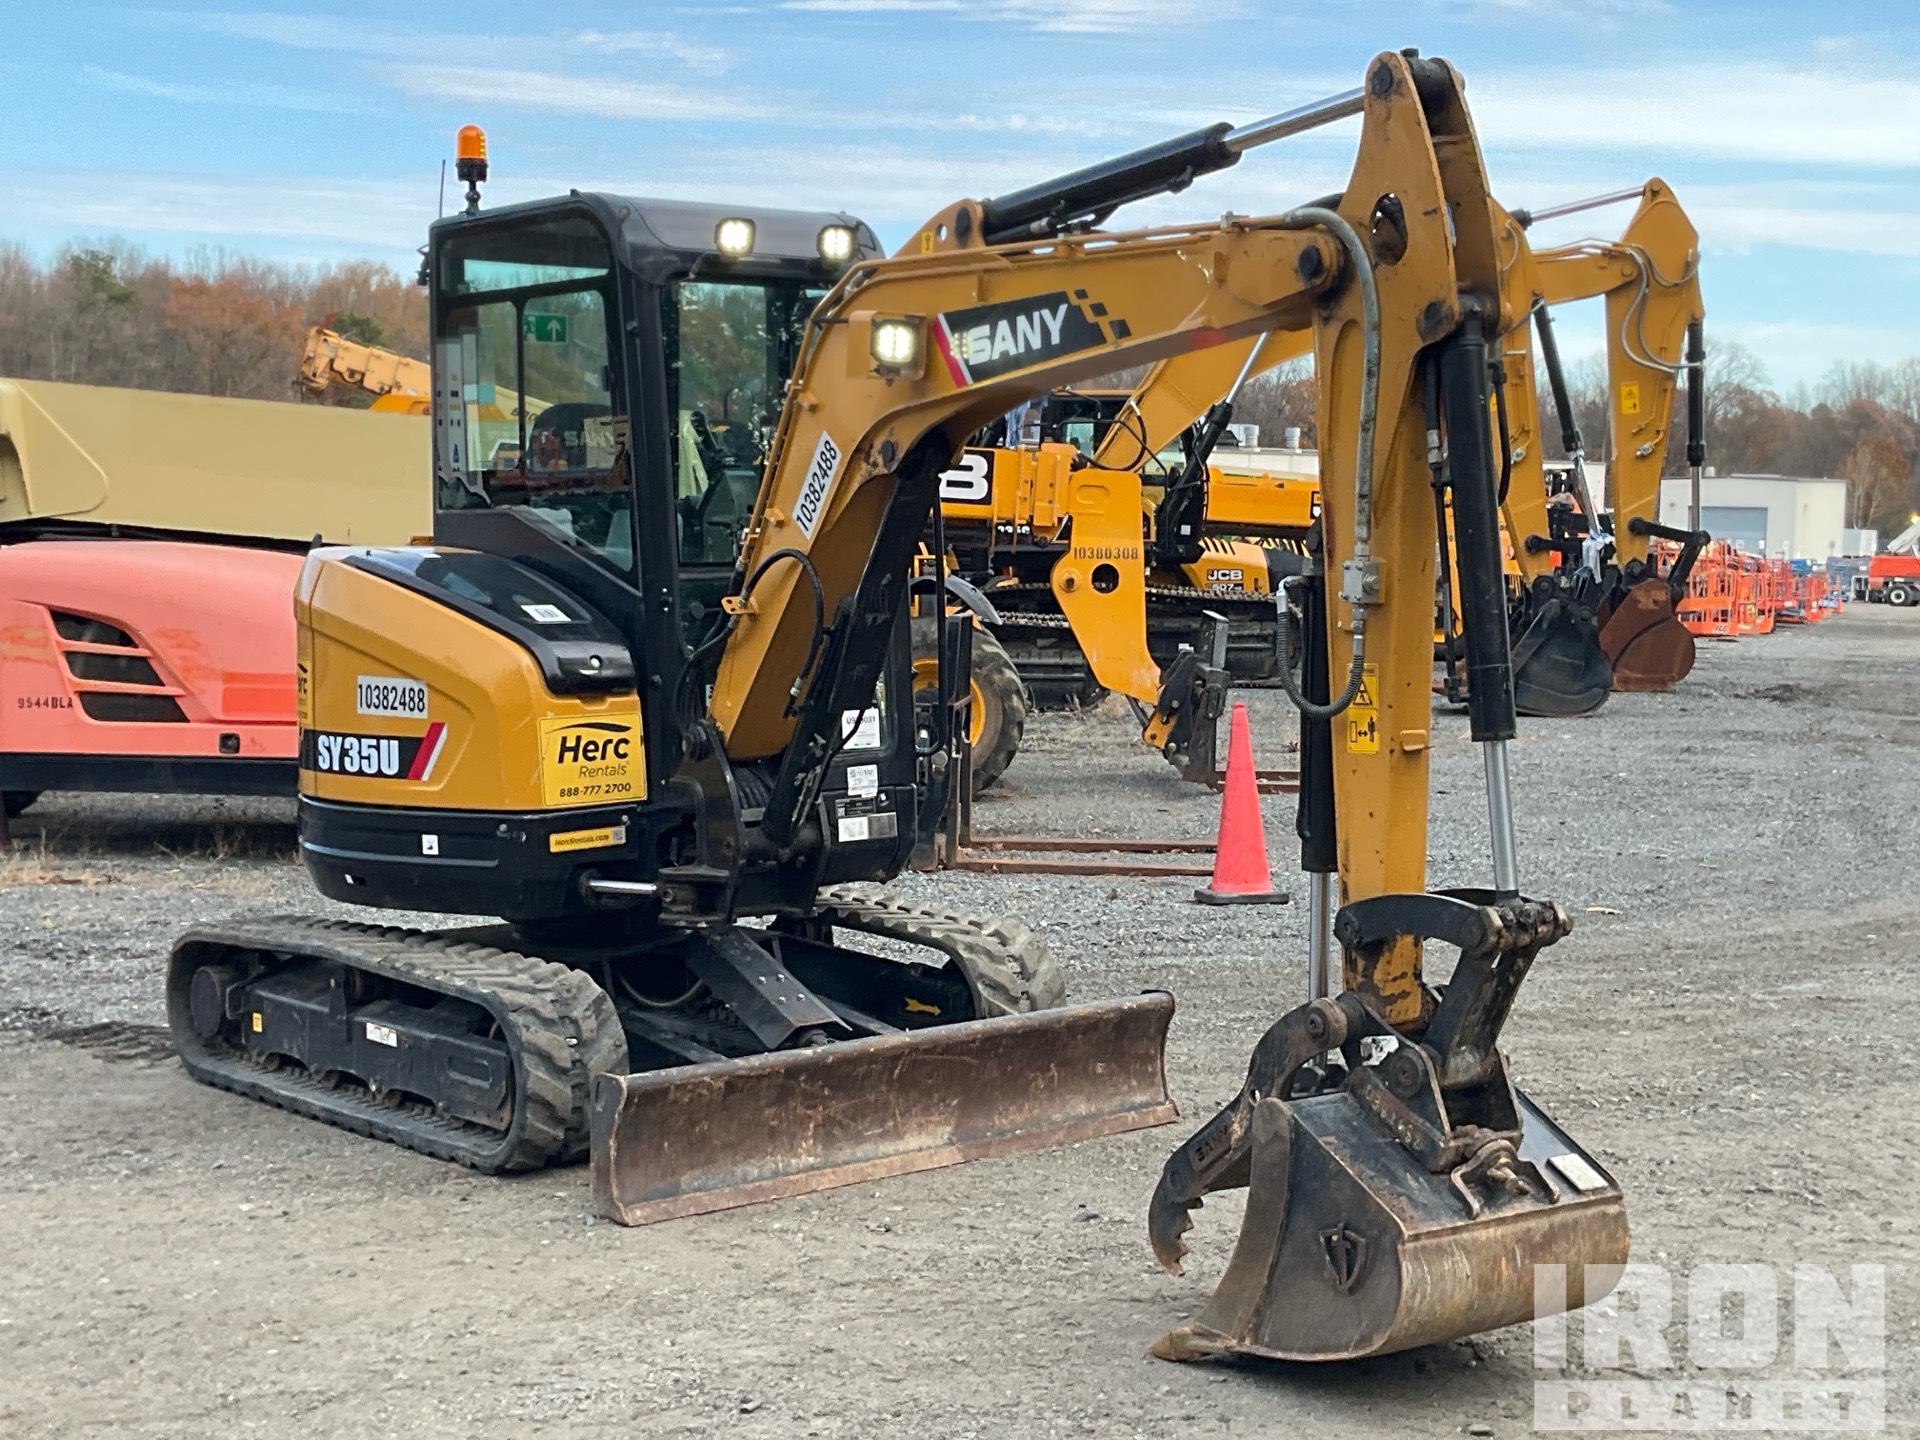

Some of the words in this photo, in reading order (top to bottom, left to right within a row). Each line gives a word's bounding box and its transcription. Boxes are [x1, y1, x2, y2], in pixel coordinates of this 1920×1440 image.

[968, 303, 1069, 367] SANY
[796, 439, 838, 532] 10382488
[1073, 546, 1139, 561] 10380308
[1207, 568, 1243, 581] JCB
[358, 683, 426, 713] 10382488
[317, 734, 400, 776] SY35U
[557, 734, 631, 764] Herc
[578, 763, 628, 779] Rentals
[559, 782, 632, 798] 888-777-2700
